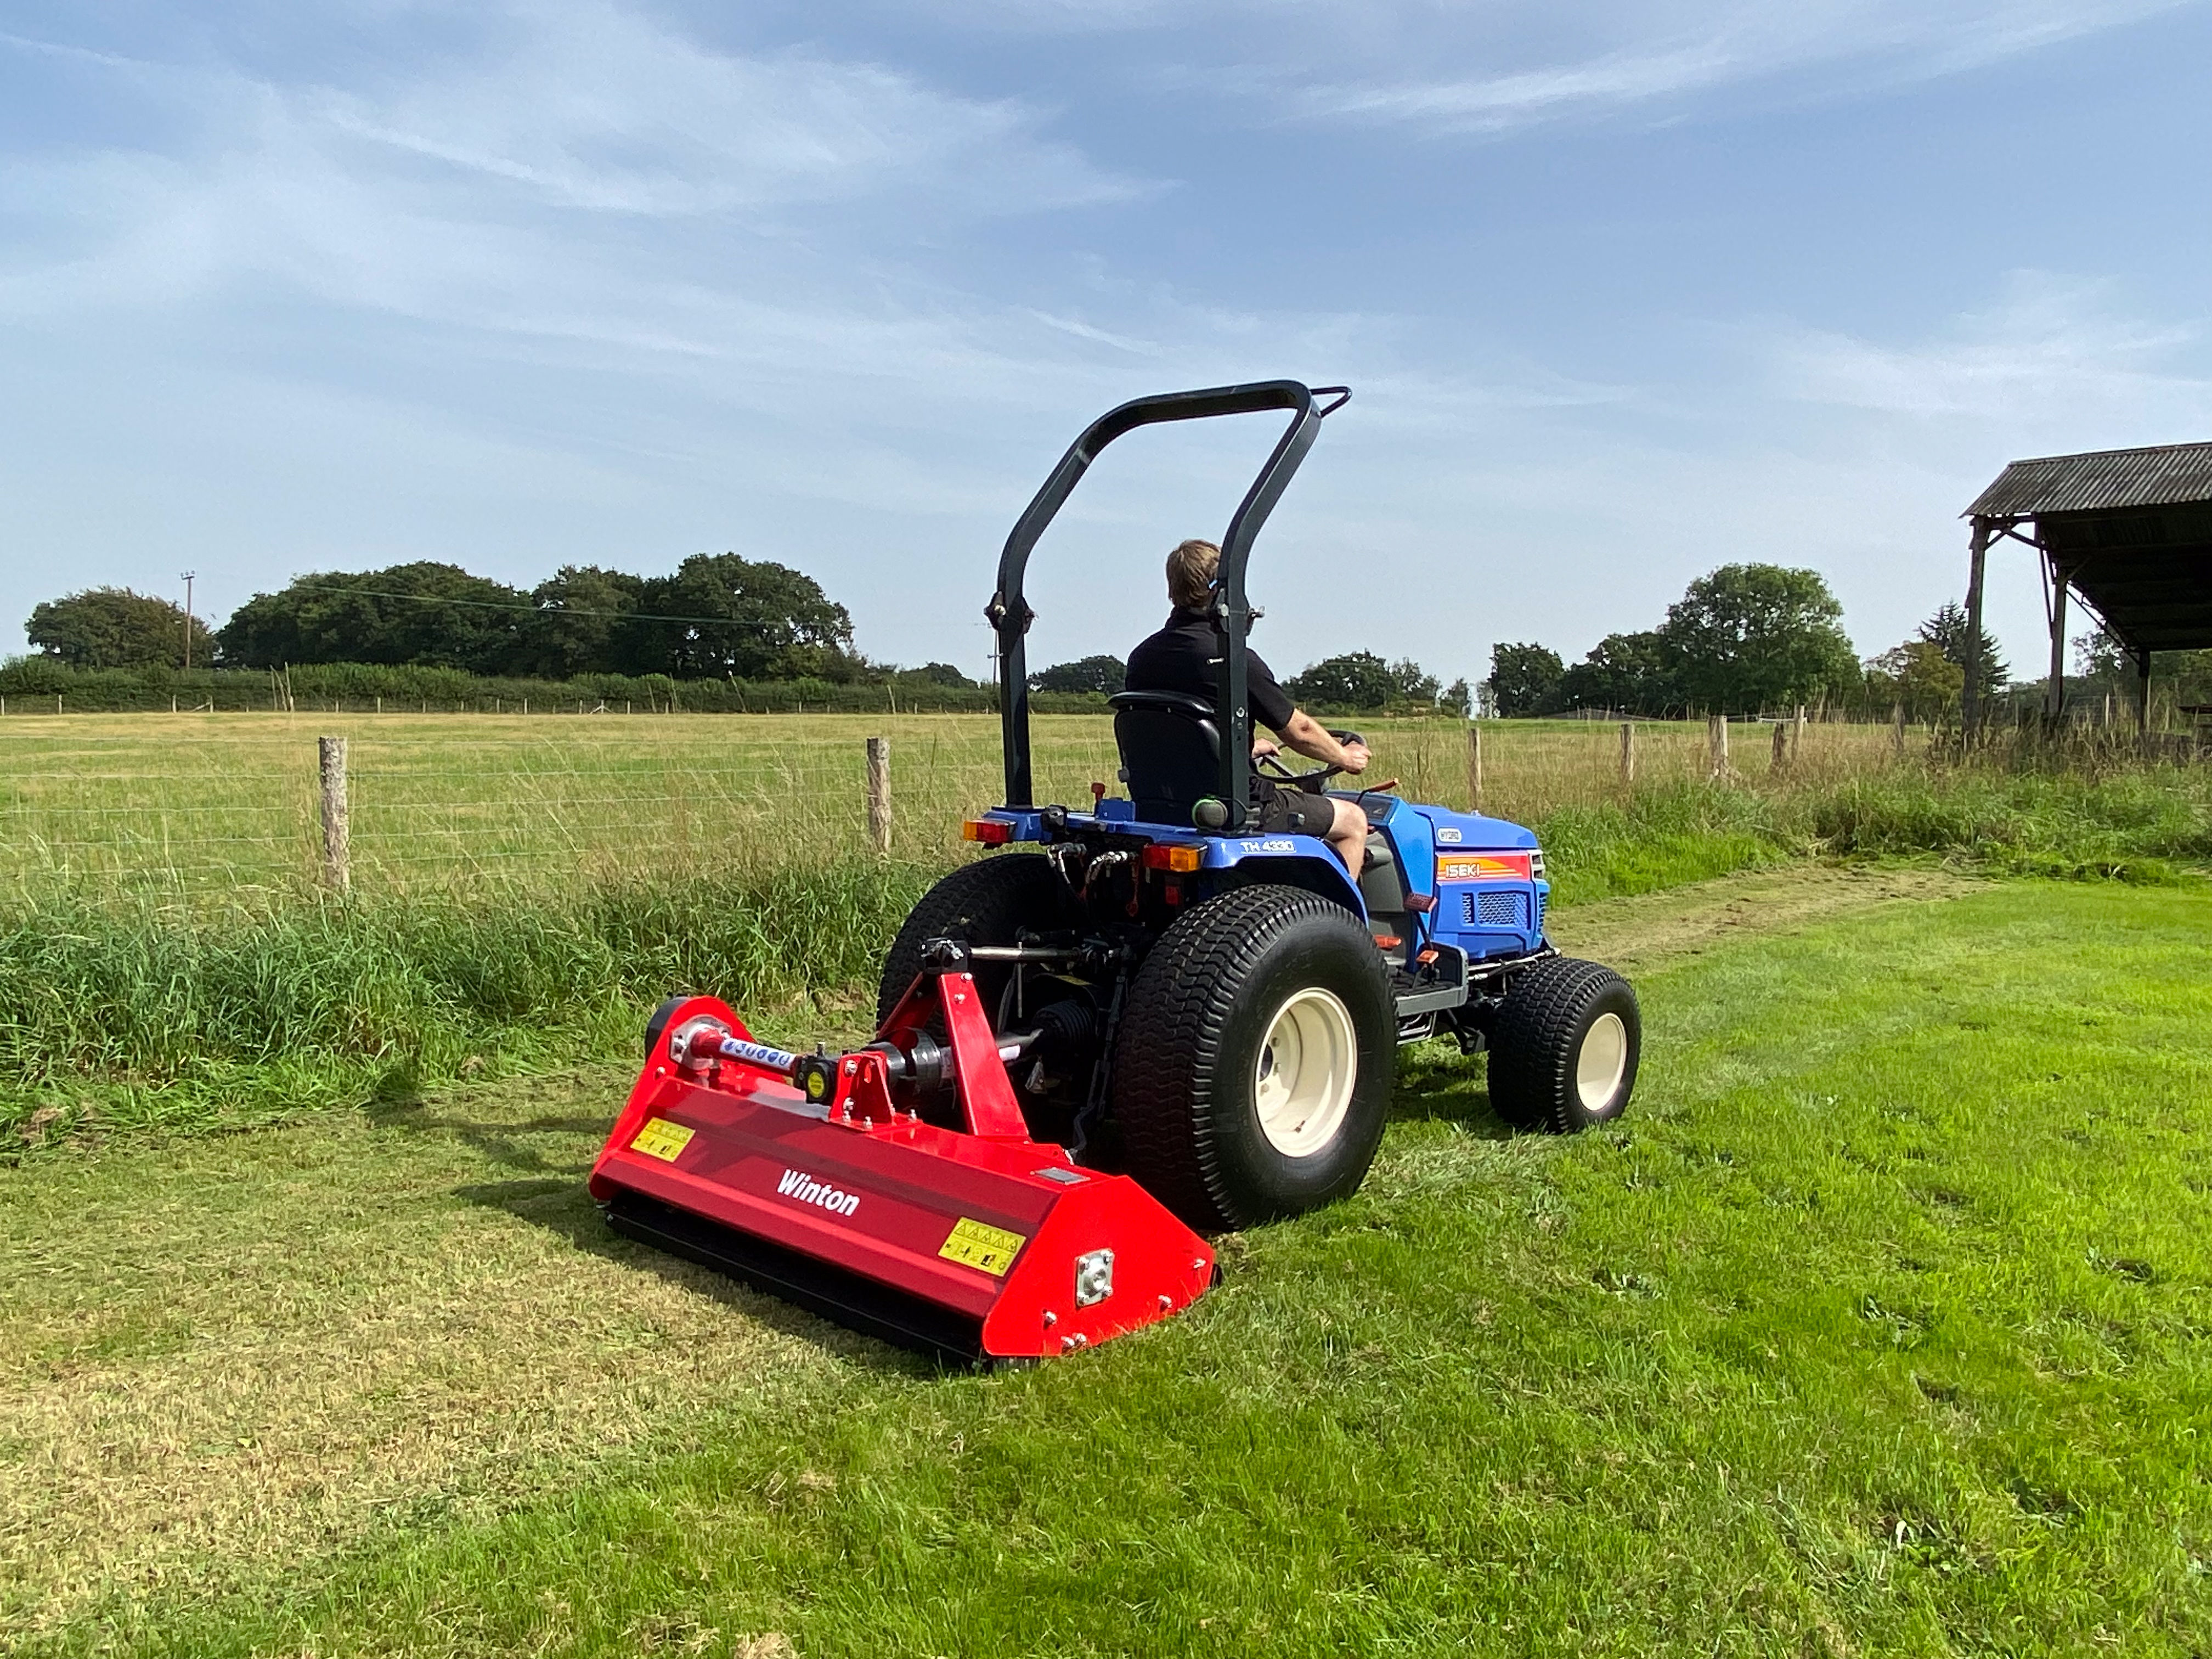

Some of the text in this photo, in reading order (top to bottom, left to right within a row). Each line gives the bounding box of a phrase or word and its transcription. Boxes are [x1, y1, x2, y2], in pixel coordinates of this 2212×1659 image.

[1240, 841, 1261, 853] TH
[1446, 863, 1480, 878] ISEKI
[777, 1169, 860, 1216] Winton
